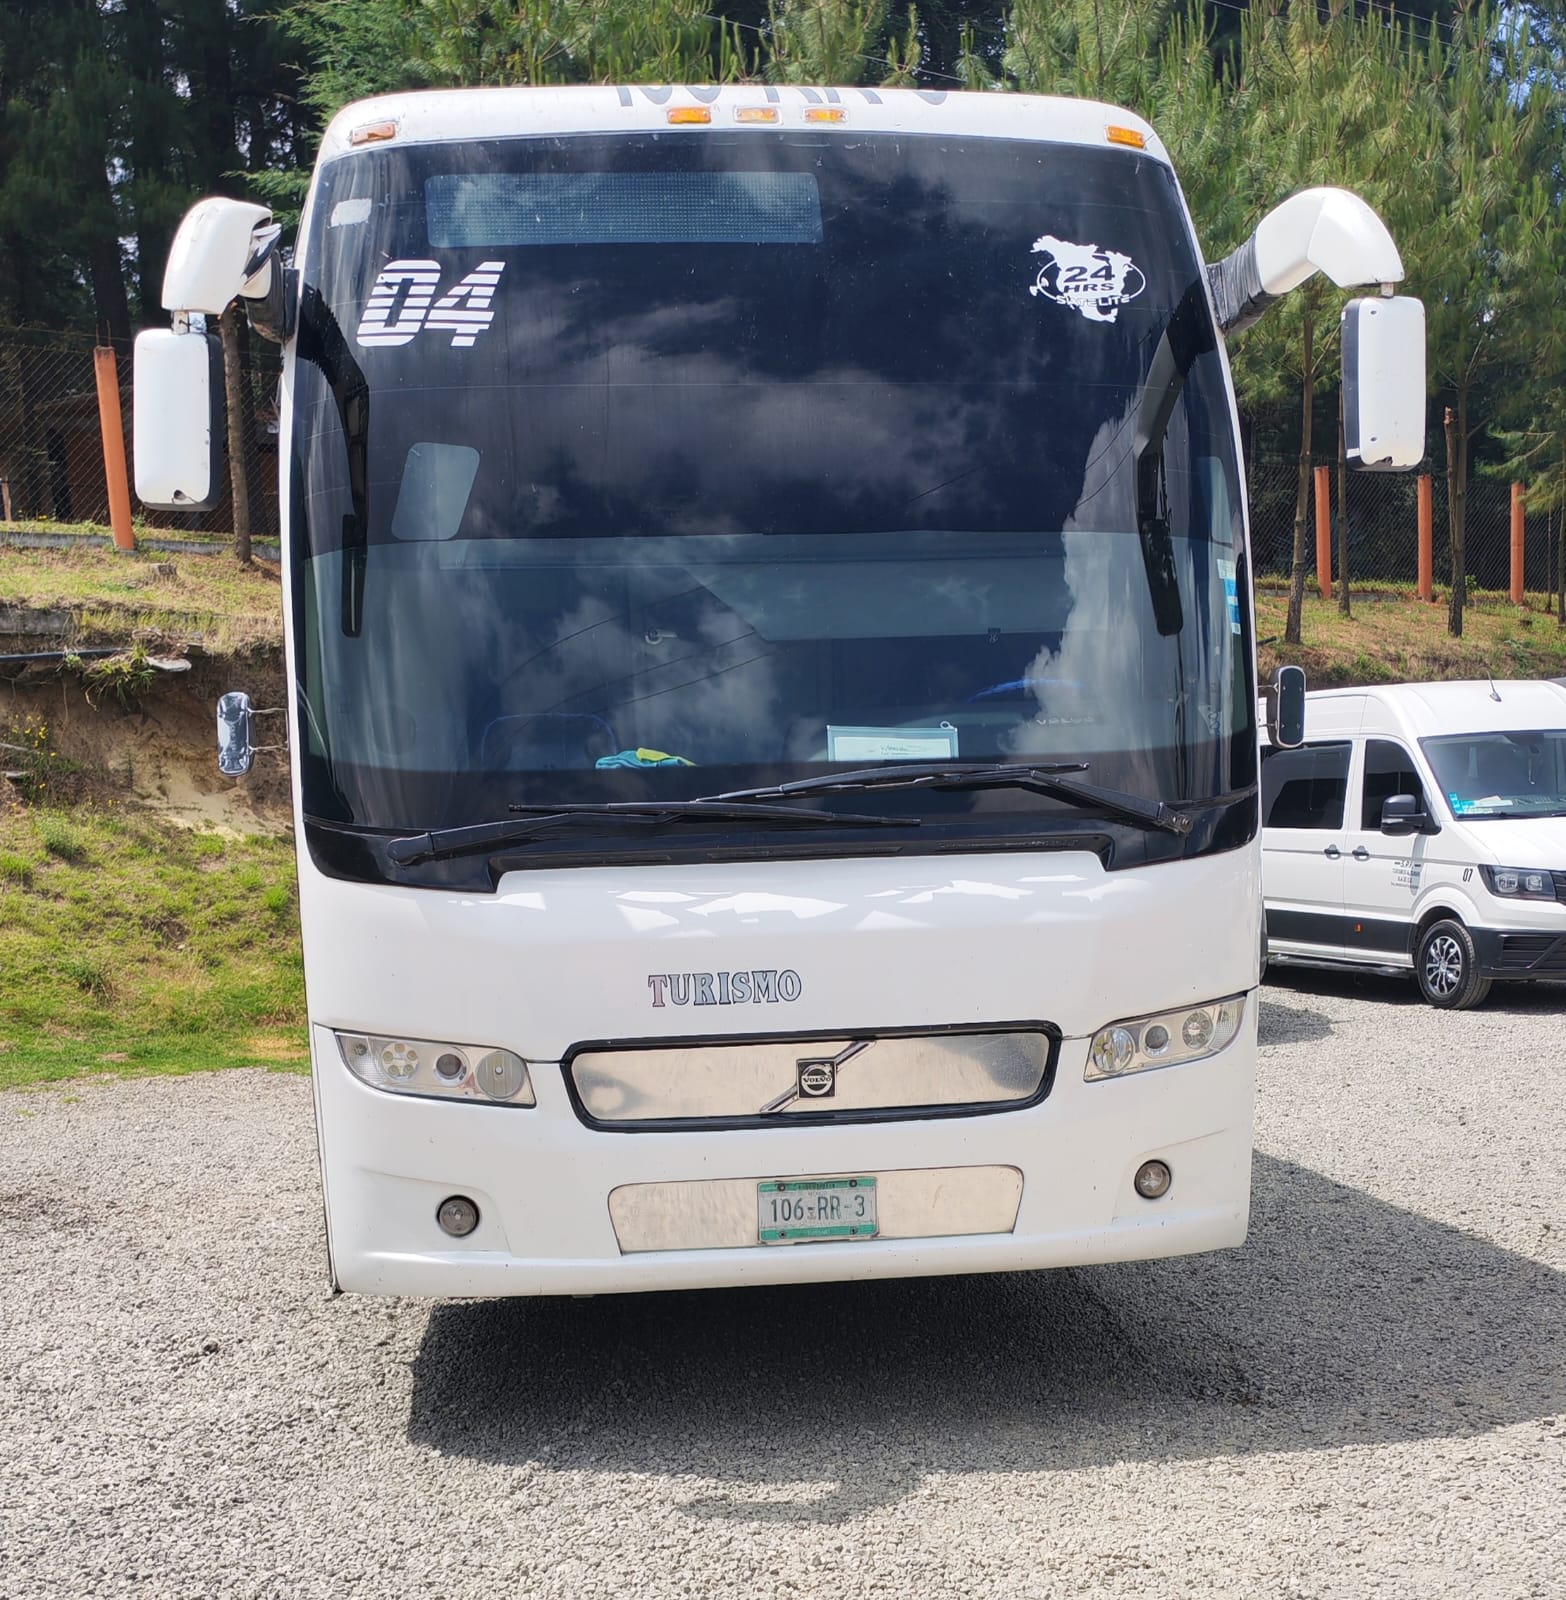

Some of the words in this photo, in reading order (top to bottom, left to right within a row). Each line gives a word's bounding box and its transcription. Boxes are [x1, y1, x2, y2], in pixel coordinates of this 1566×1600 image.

[1063, 265, 1115, 283] 24
[1063, 282, 1115, 293] HRS
[356, 259, 506, 347] 04
[1462, 868, 1473, 882] 07
[648, 969, 802, 1007] TURISMO
[771, 1194, 865, 1222] 106-RR-3
